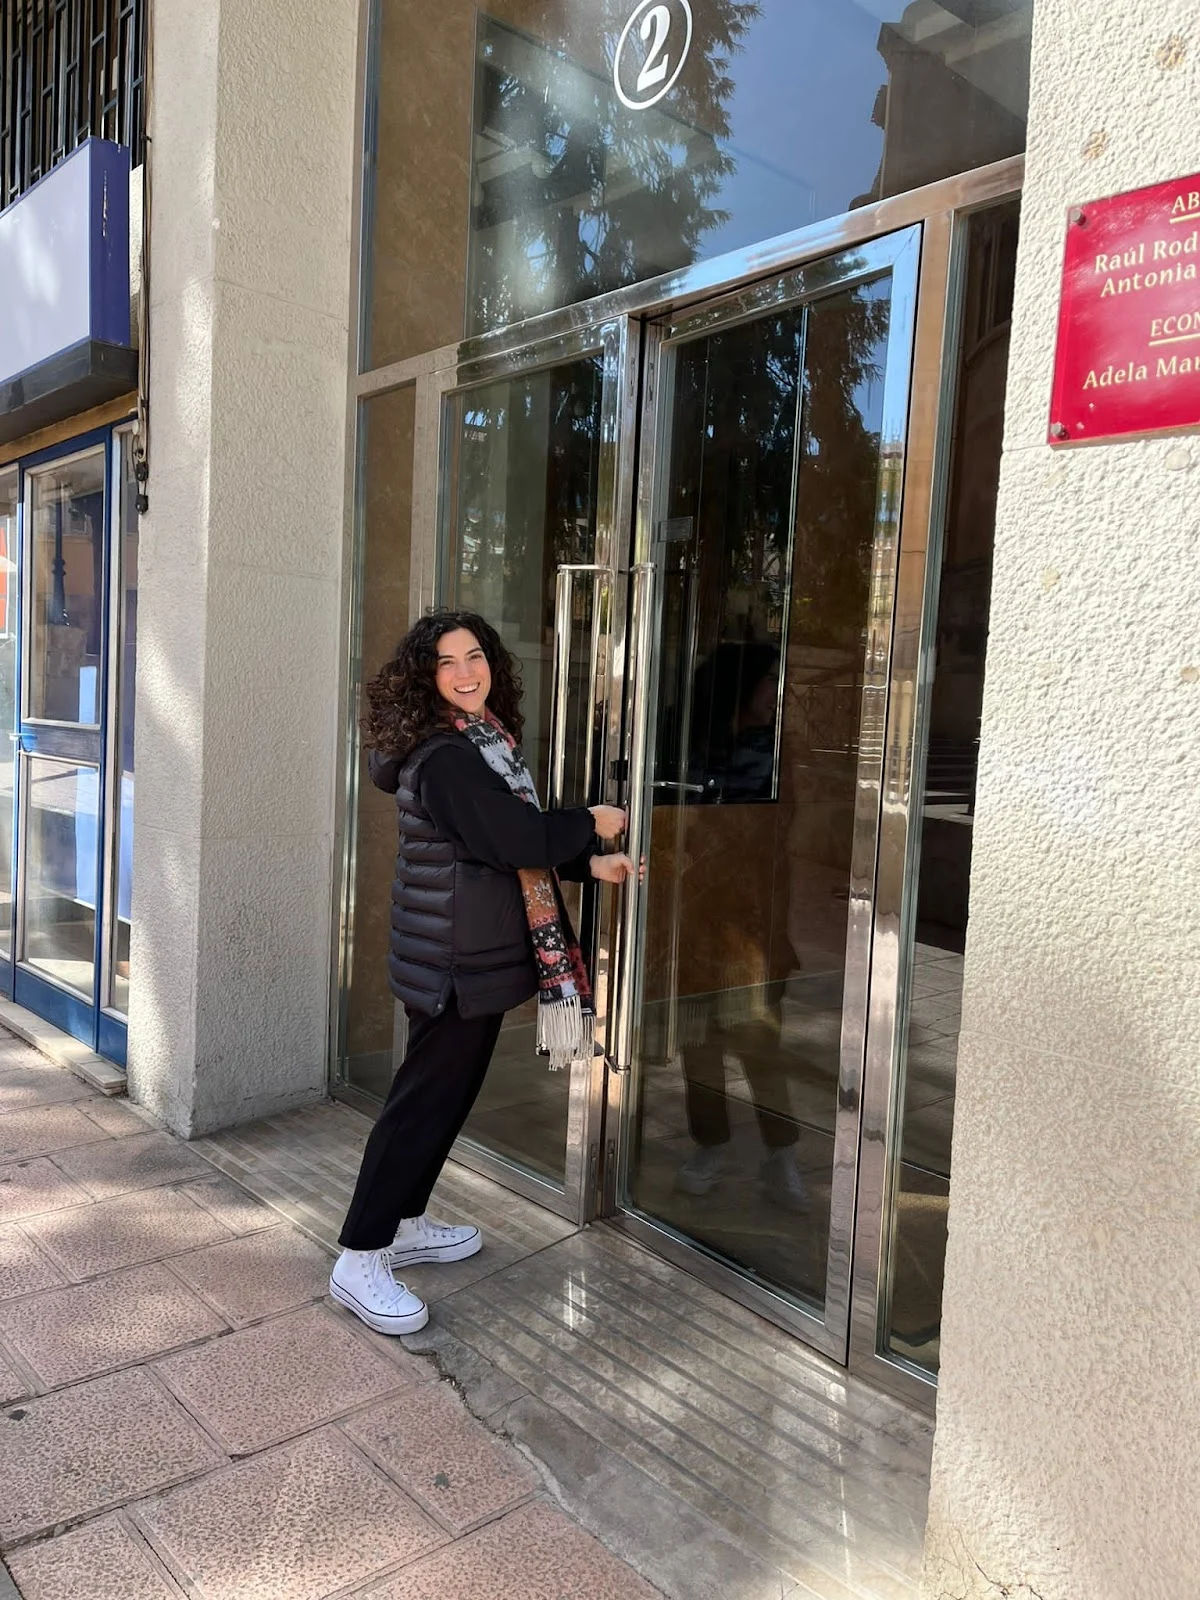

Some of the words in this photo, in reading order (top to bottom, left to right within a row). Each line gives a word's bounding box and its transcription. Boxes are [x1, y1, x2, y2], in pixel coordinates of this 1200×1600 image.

[637, 5, 671, 92] 2
[1171, 191, 1200, 214] AB
[1095, 243, 1145, 275] Raúl
[1153, 231, 1198, 260] Rod
[1100, 262, 1197, 298] Antonia
[1082, 362, 1148, 390] Adela
